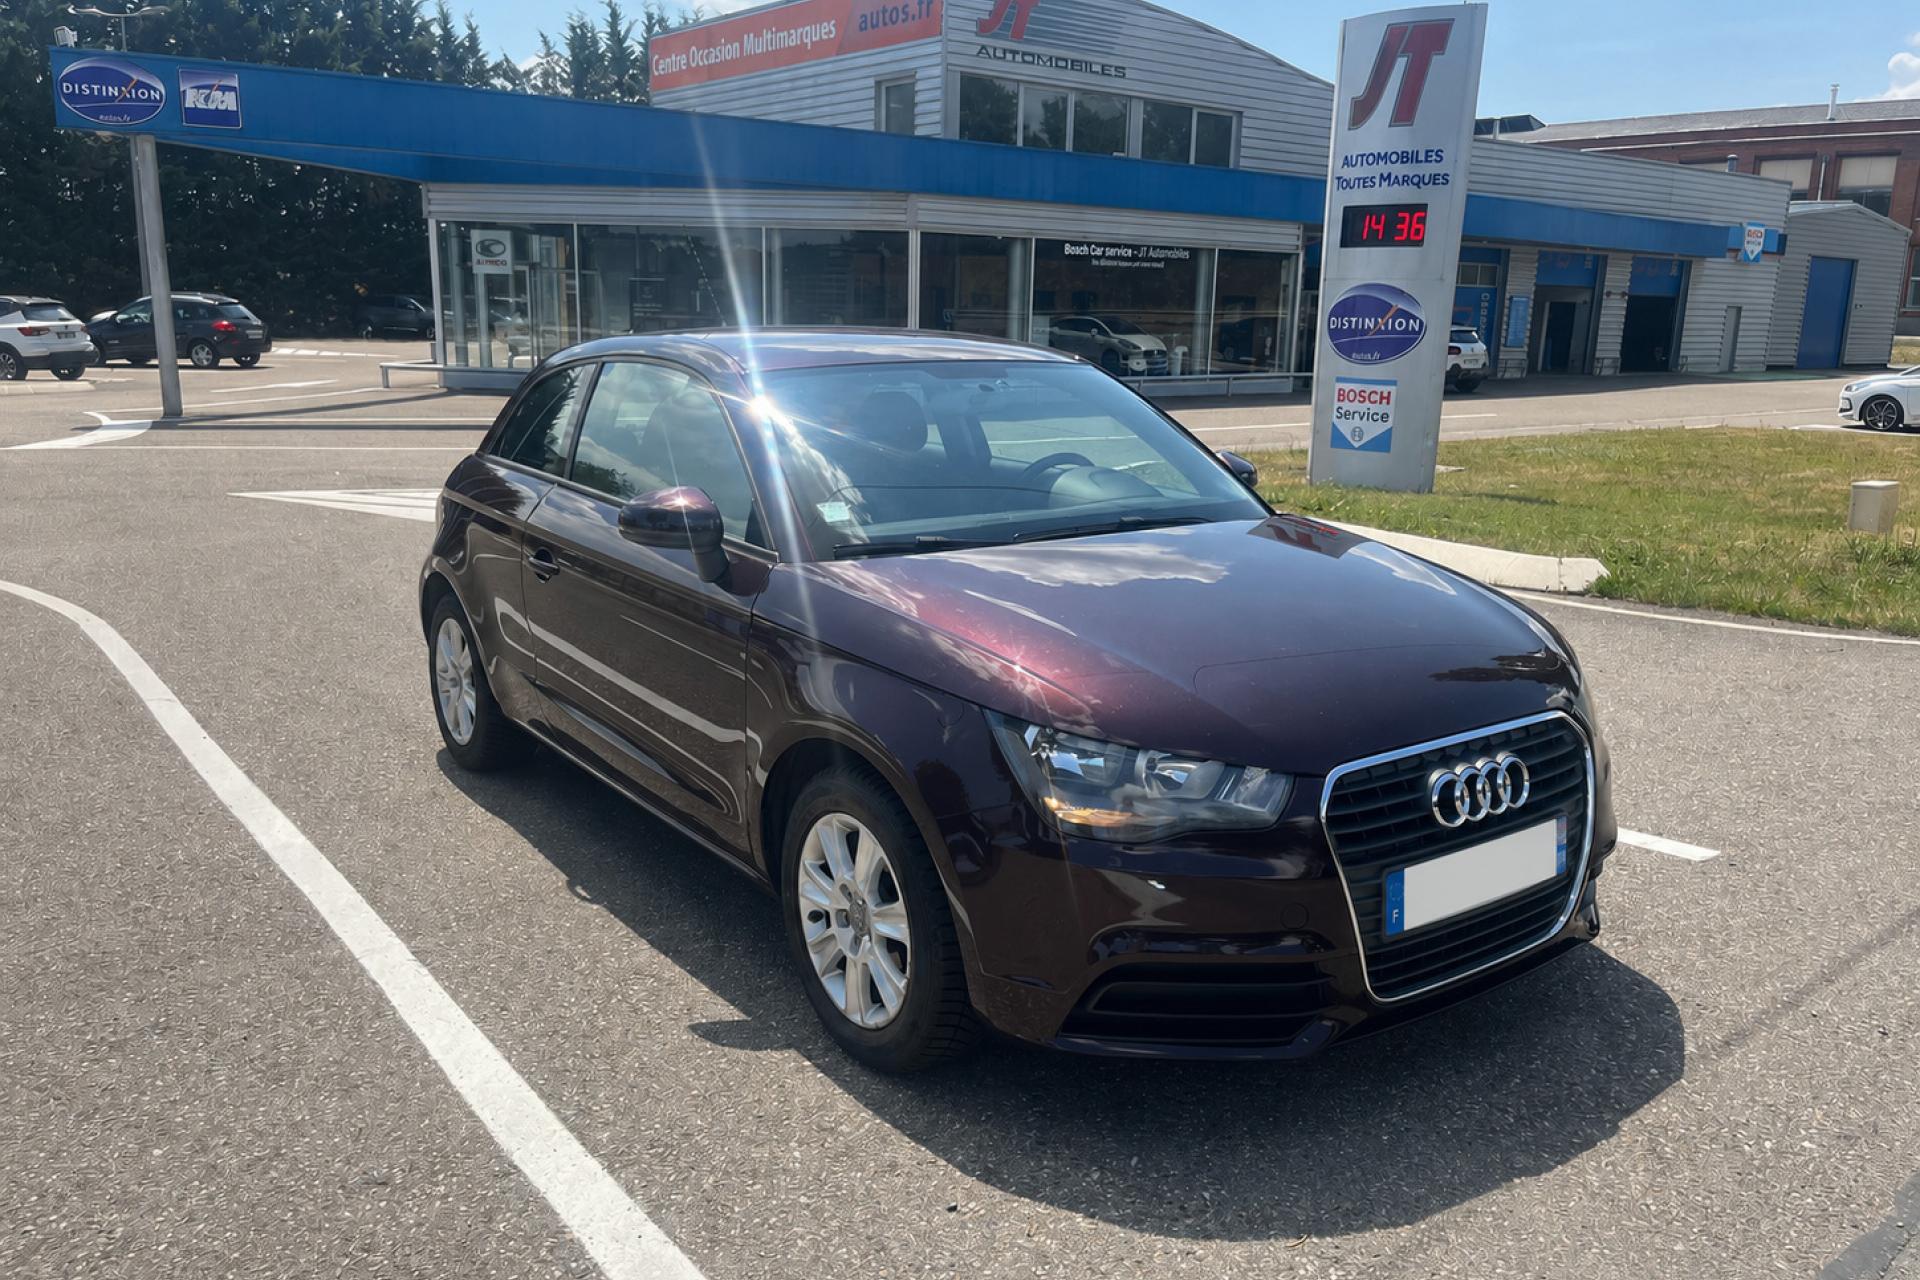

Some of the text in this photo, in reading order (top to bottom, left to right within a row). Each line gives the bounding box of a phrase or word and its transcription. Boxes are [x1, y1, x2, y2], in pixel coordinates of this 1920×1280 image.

[858, 0, 934, 33] autos.fr
[652, 19, 837, 76] Centre Occasion Multimarques
[976, 44, 1127, 79] AUTOMOBILES
[1347, 18, 1455, 131] JT
[62, 81, 161, 101] DISTINXION
[1341, 149, 1445, 168] AUTOMOBILES
[1335, 172, 1450, 191] TOUTES MARQUES
[1362, 211, 1427, 241] 14 36
[1064, 243, 1089, 255] Bosch
[1090, 244, 1104, 256] Car
[1105, 245, 1132, 257] service
[1138, 246, 1147, 258] JT
[1330, 316, 1420, 332] DISTINXION
[1337, 388, 1392, 405] BOSCH
[1336, 406, 1390, 423] Service
[1392, 909, 1400, 923] F
